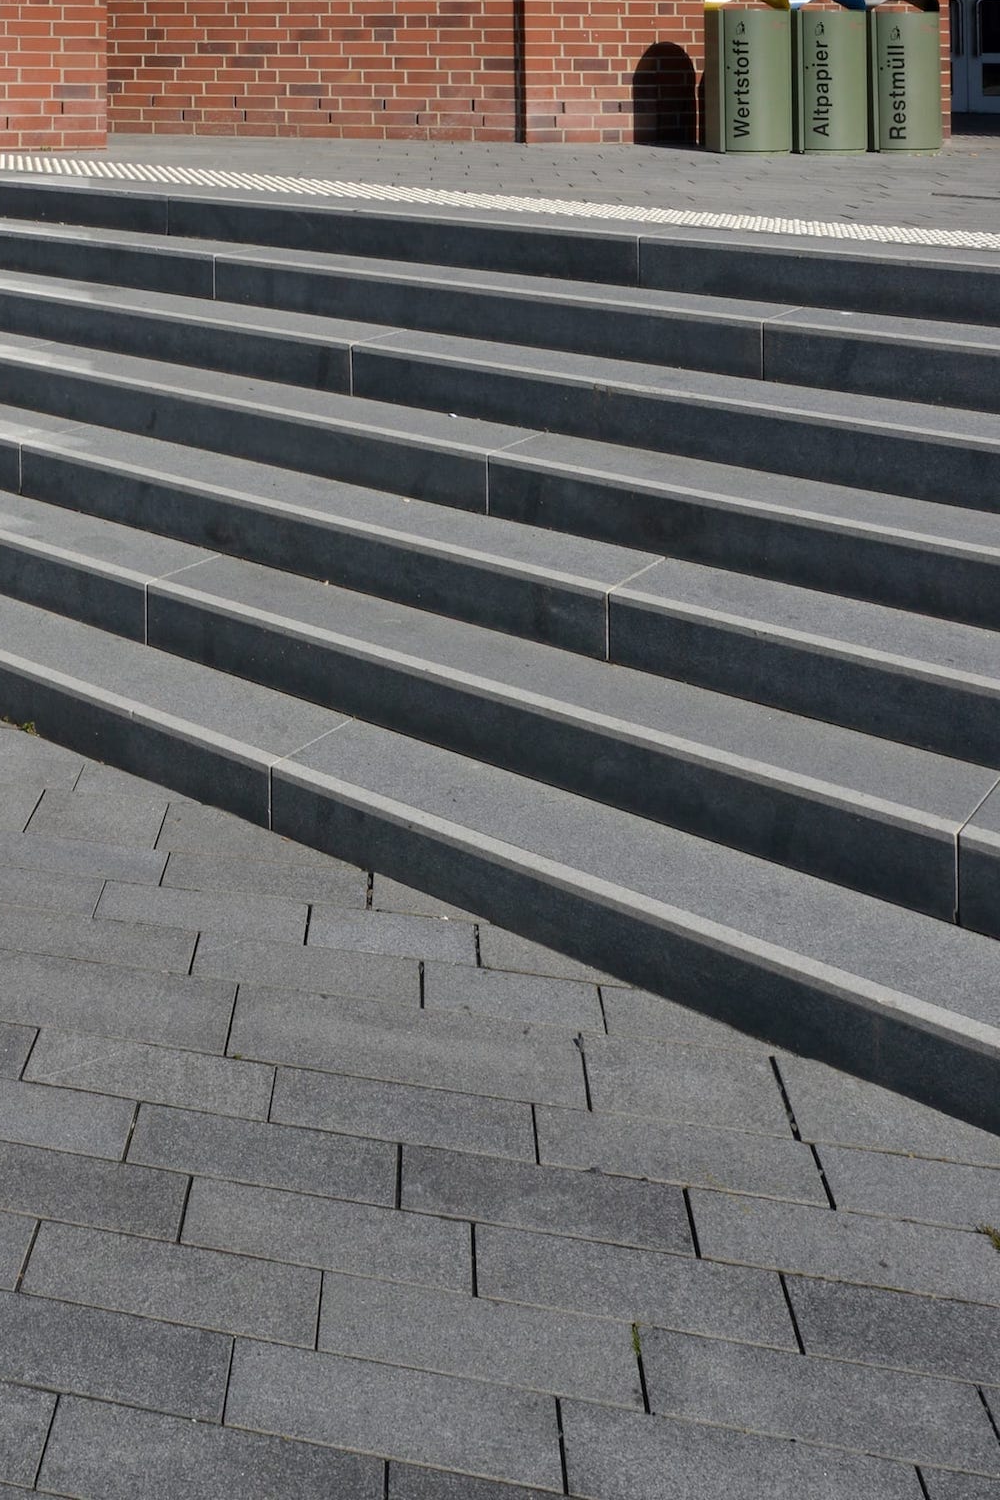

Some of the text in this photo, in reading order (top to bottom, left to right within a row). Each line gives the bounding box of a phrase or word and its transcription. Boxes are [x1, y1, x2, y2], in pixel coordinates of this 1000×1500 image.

[732, 39, 751, 138] Wertstoff
[812, 40, 833, 137] Altpapier
[887, 45, 907, 140] Restmüll
